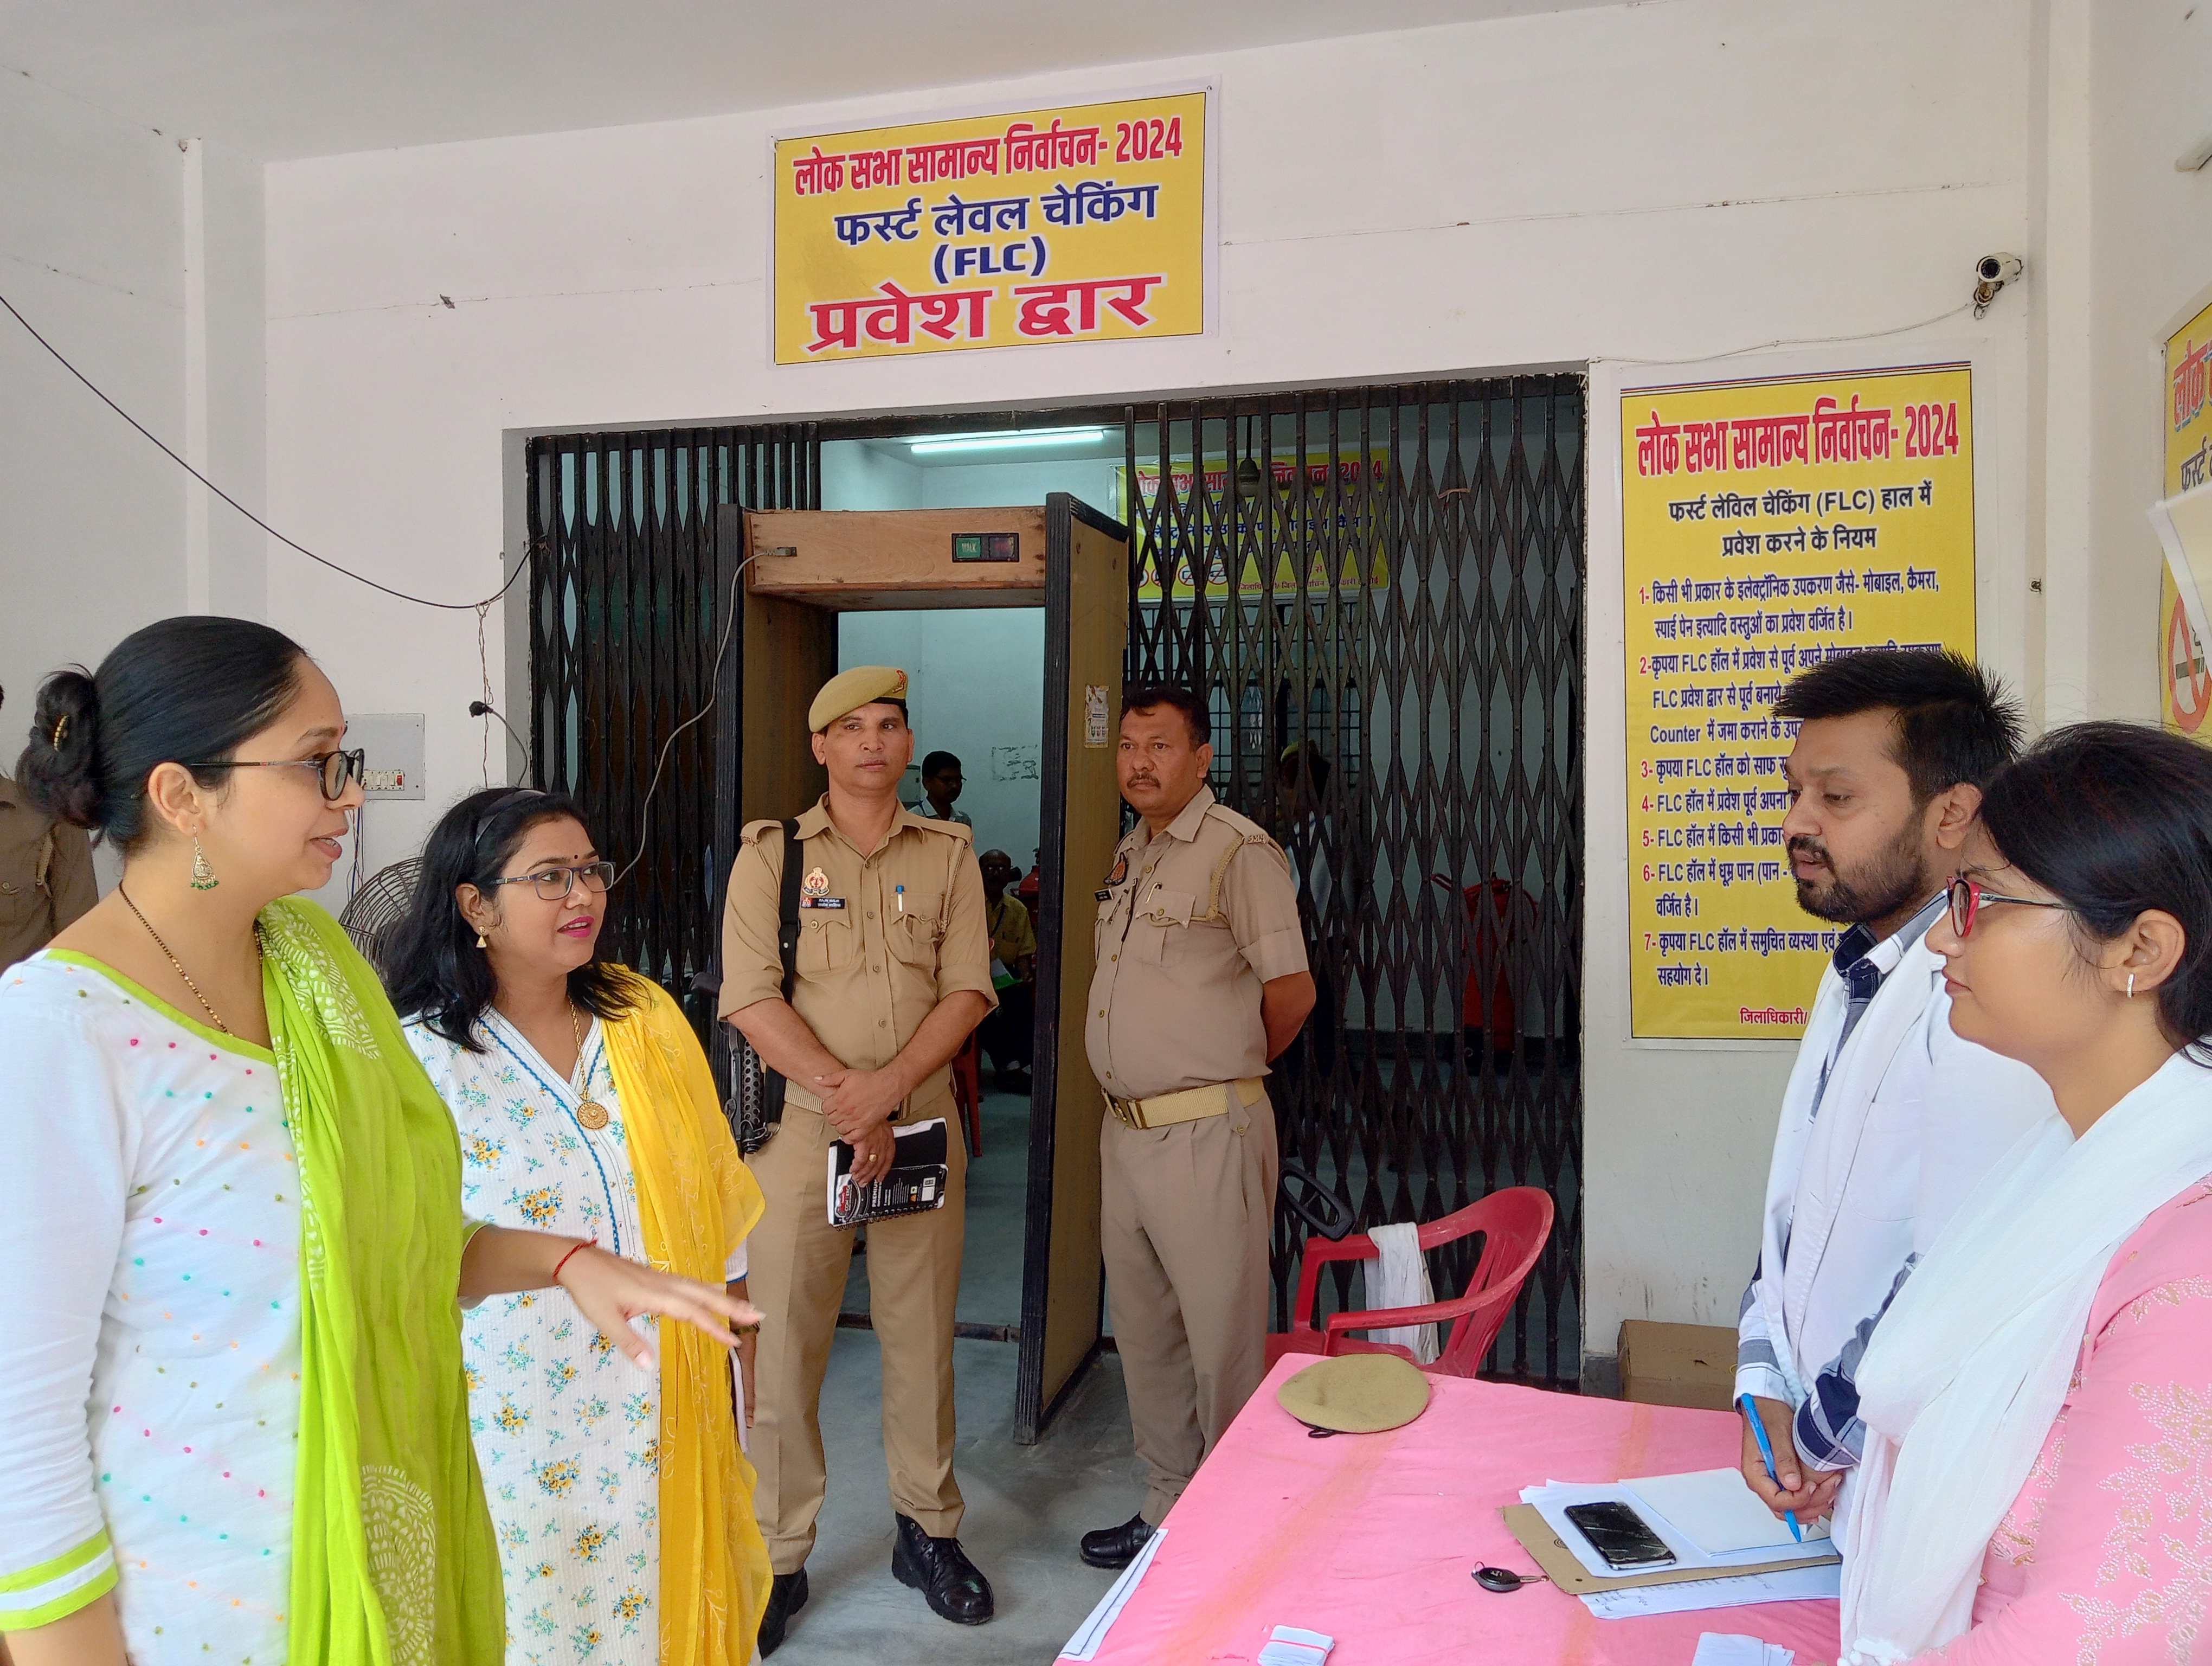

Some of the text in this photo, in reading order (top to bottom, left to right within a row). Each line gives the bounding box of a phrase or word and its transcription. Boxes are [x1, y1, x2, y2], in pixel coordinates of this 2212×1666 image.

[793, 146, 846, 195] लोक
[849, 148, 903, 190] सभा
[906, 138, 1001, 183] सामान्य
[1116, 112, 1182, 163] 2024
[835, 181, 1160, 246] फर्स्ट लेवल चेकिंग
[935, 237, 1046, 284] (FLC)
[808, 277, 1162, 354] प्रवेश द्वार
[1636, 411, 1679, 477] लोक
[1683, 421, 1728, 473] सभा
[1731, 414, 1809, 470] सामान्य
[1905, 402, 1959, 459] 2024
[1340, 459, 1384, 483] 204
[1669, 479, 1932, 521] फर्स्ट लेविल चेकिंग (FLC) हाल में
[1721, 523, 1877, 556] प्रवेश करने के नियम
[1652, 580, 1678, 604] किसी
[1681, 578, 1692, 602] भी
[1695, 582, 1721, 602] प्रकार
[1725, 576, 1735, 600] के
[1792, 575, 1832, 595] उपकरण
[1654, 613, 1676, 640] स्पाई
[1679, 613, 1693, 637] पेन
[1696, 612, 1727, 639] इत्यादि
[1730, 609, 1762, 640] वस्तुओं
[1765, 615, 1779, 633] का
[1782, 607, 1805, 633] प्रवेश
[1808, 606, 1835, 631] वर्जित
[1682, 653, 1707, 672] FLC
[1710, 647, 1729, 672] हॉल
[1732, 645, 1740, 670] में
[1742, 645, 1765, 670] प्रवेश
[1769, 644, 1779, 669] से
[1782, 643, 1796, 674] पूर्व
[1654, 690, 1678, 708] FLC
[1681, 683, 1703, 708] प्रवेश
[1707, 688, 1724, 708] द्वार
[1726, 682, 1735, 706] से
[1739, 681, 1753, 712] पूर्व
[1650, 726, 1701, 744] Counter
[1718, 722, 1737, 741] जमा
[1740, 717, 1767, 741] कराने
[1771, 715, 1782, 739] के
[1656, 760, 1683, 784] कृपया
[1687, 759, 1711, 777] FLC
[1714, 752, 1734, 778] हॉल
[1737, 752, 1750, 776] को
[1753, 757, 1777, 775] साफ
[1657, 794, 1682, 812] FLC
[1685, 788, 1704, 813] हॉल
[1717, 787, 1740, 811] प्रवेश
[1743, 786, 1757, 816] पूर्व
[1760, 792, 1789, 810] अपना
[1658, 829, 1682, 847] FLC
[1686, 823, 1705, 848] हॉल
[1718, 823, 1744, 846] किसी
[1747, 821, 1758, 845] भी
[1659, 864, 1683, 881] FLC
[1687, 858, 1705, 882] हॉल
[1737, 863, 1754, 881] पान
[1656, 893, 1681, 917] वर्जित
[1659, 933, 1686, 956] कृपया
[1690, 933, 1714, 951] FLC
[1718, 927, 1737, 952] हॉल
[1751, 931, 1785, 956] समुचित
[1657, 963, 1692, 986] सहयोग
